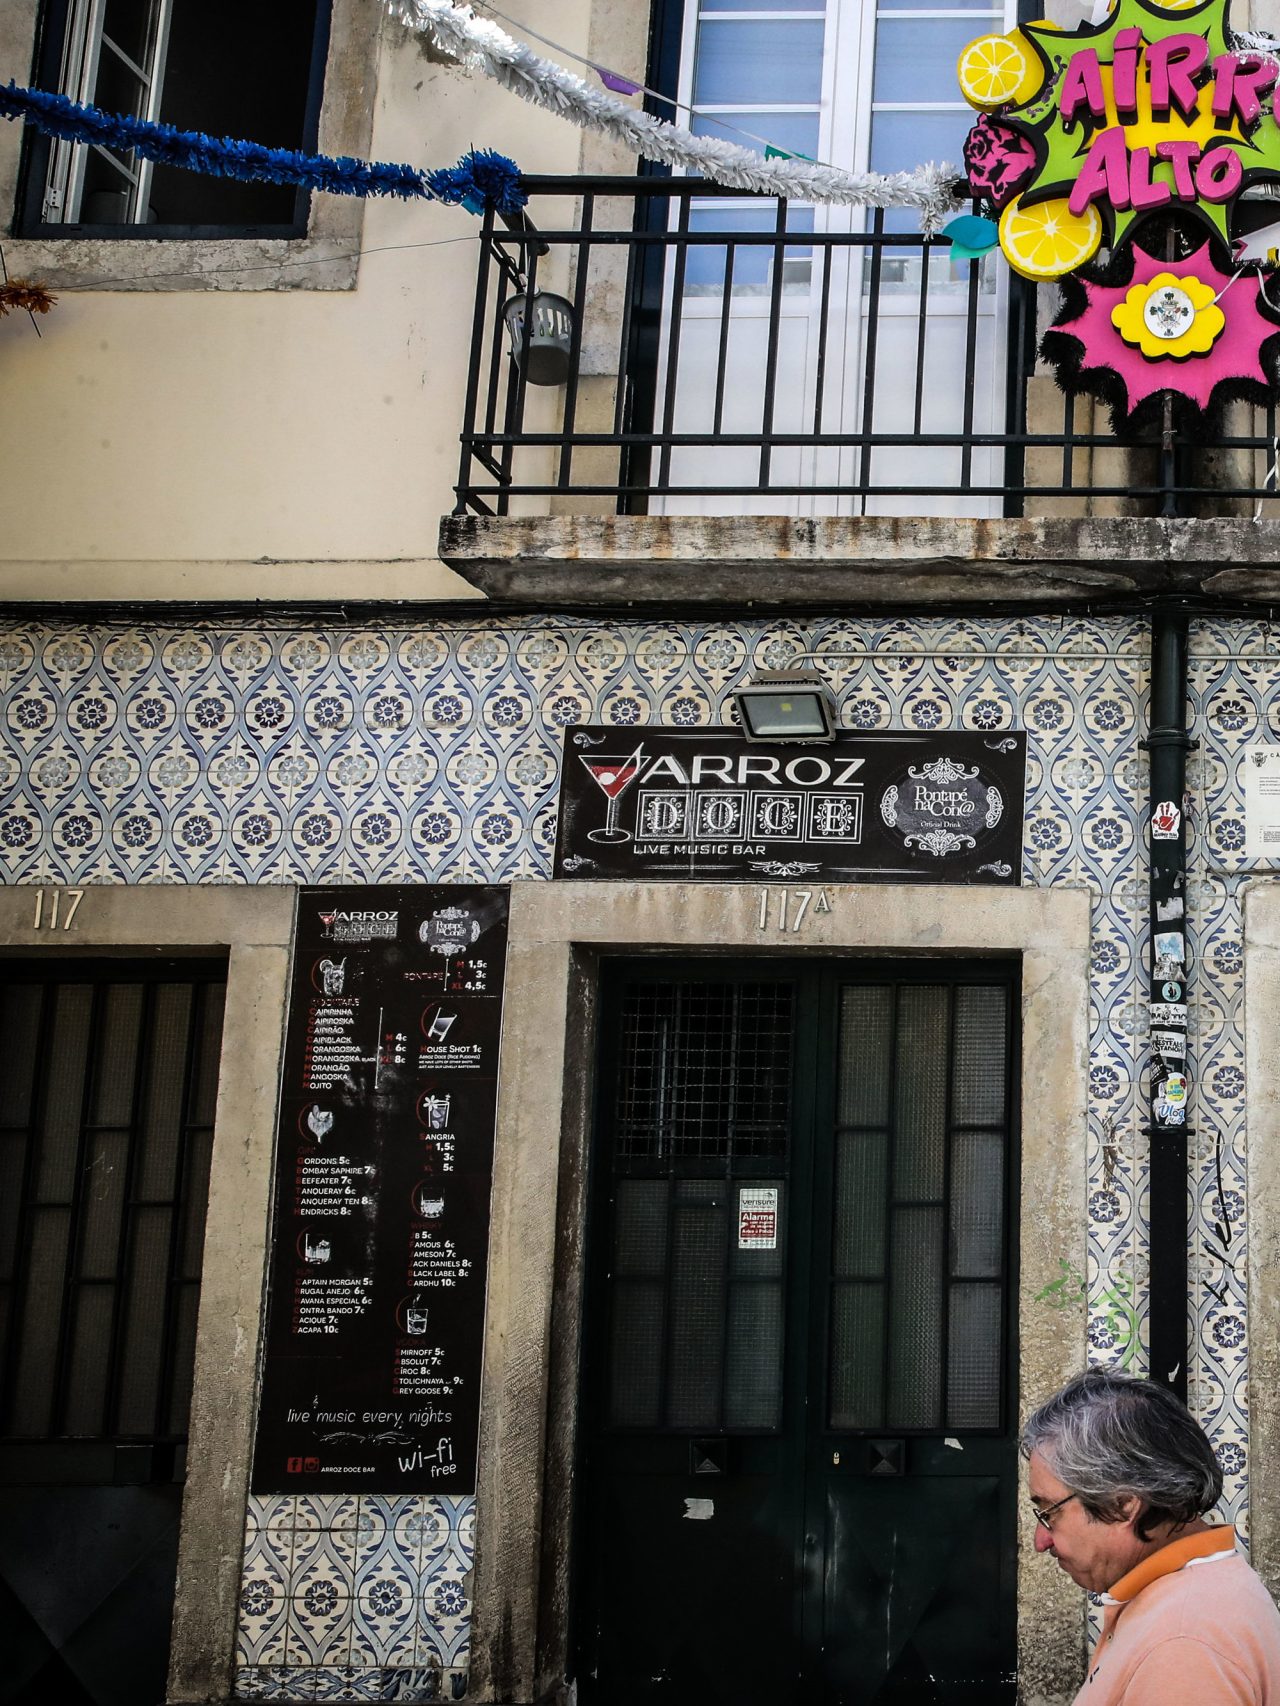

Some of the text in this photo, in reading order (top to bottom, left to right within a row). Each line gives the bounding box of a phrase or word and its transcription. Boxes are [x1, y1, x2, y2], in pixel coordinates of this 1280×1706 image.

[1068, 126, 1242, 217] ALTO
[640, 755, 866, 787] ARROZ
[914, 786, 967, 805] Pontapé
[645, 796, 856, 836] DOCE
[942, 821, 961, 829] Drink
[633, 844, 766, 856] LIVE MUSIC BAR
[34, 889, 84, 930] 117
[337, 911, 399, 921] ARROZ
[305, 1045, 362, 1053] MORANGOSKA
[449, 1045, 470, 1053] SHOT
[330, 1167, 363, 1175] SAPHIRE
[742, 1212, 774, 1221] Alarme
[287, 1408, 452, 1427] live music every nights
[431, 1463, 456, 1478] free
